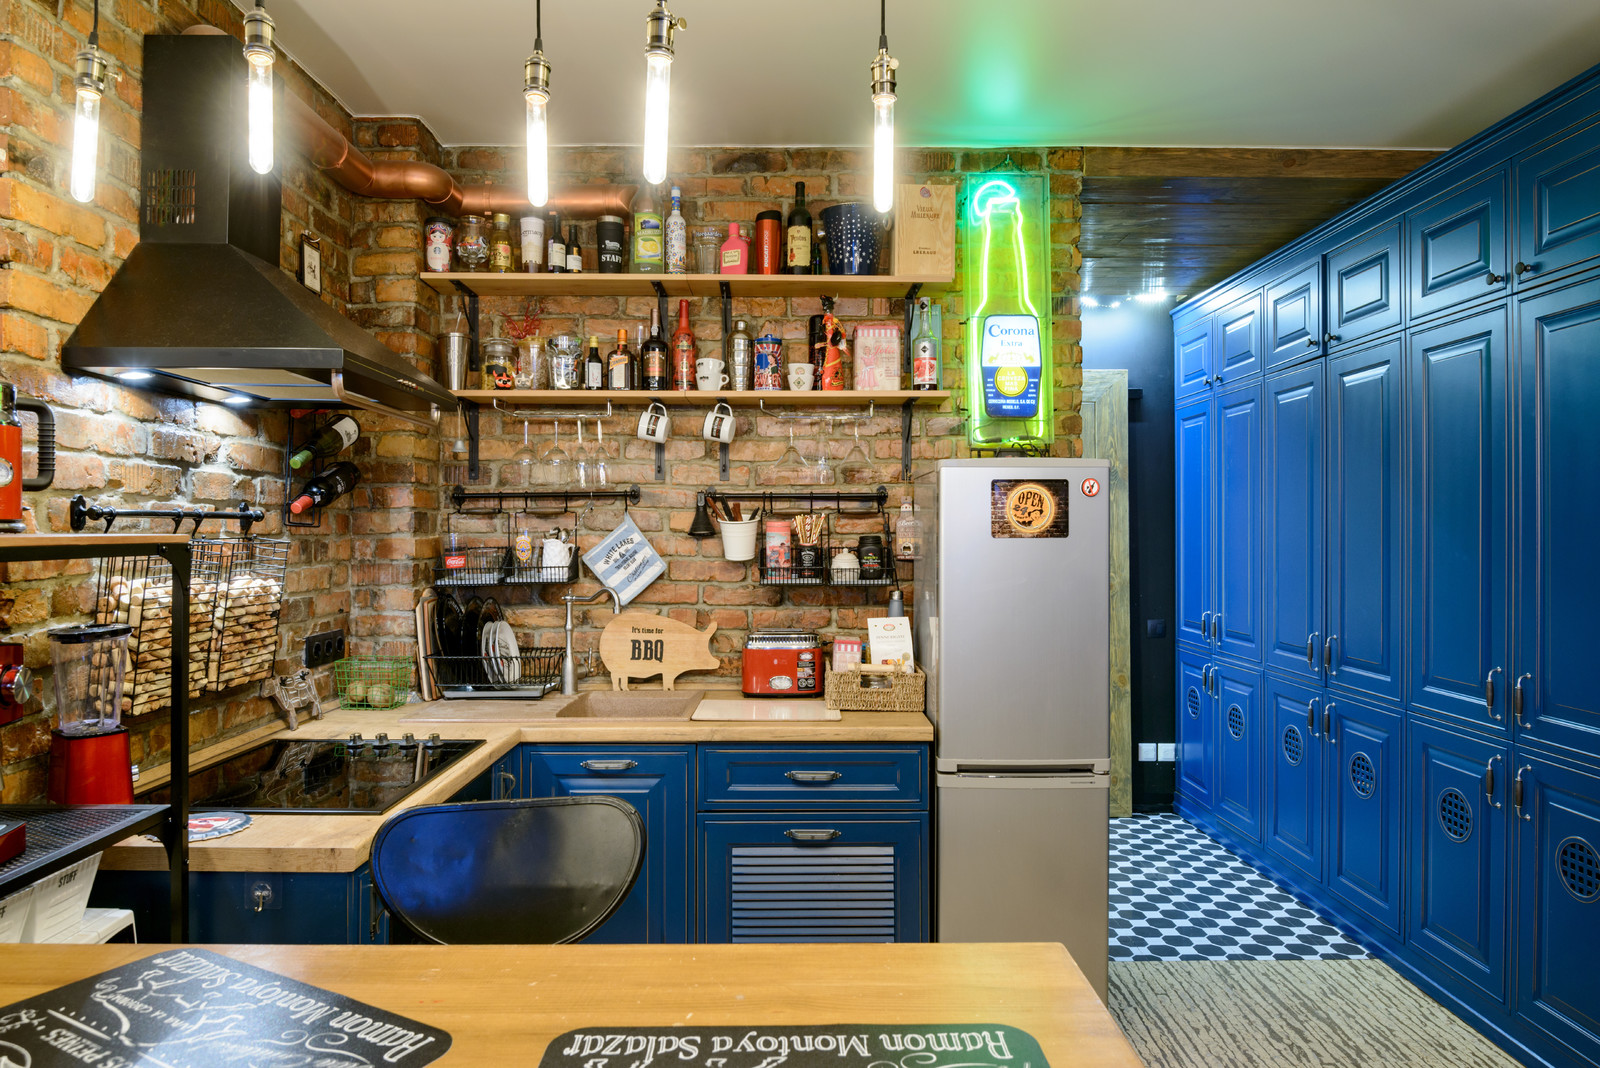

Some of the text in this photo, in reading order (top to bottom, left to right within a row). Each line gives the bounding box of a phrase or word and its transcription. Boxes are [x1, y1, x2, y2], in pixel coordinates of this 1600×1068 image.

[988, 324, 1035, 338] Corona
[1000, 339, 1023, 347] Extra
[1013, 504, 1028, 515] 24
[1018, 491, 1044, 509] OPEN
[603, 546, 618, 565] WHITE
[615, 537, 635, 550] LAKES
[631, 626, 641, 634] It's
[655, 627, 664, 635] for
[630, 639, 664, 663] BBQ
[58, 869, 78, 887] STUFF
[152, 951, 242, 989] Salazar
[229, 980, 339, 1025] Montoya
[40, 1028, 112, 1063] PEINES
[329, 1011, 435, 1062] Ramon
[563, 1031, 1014, 1061] Ramon Montoya Salazar
